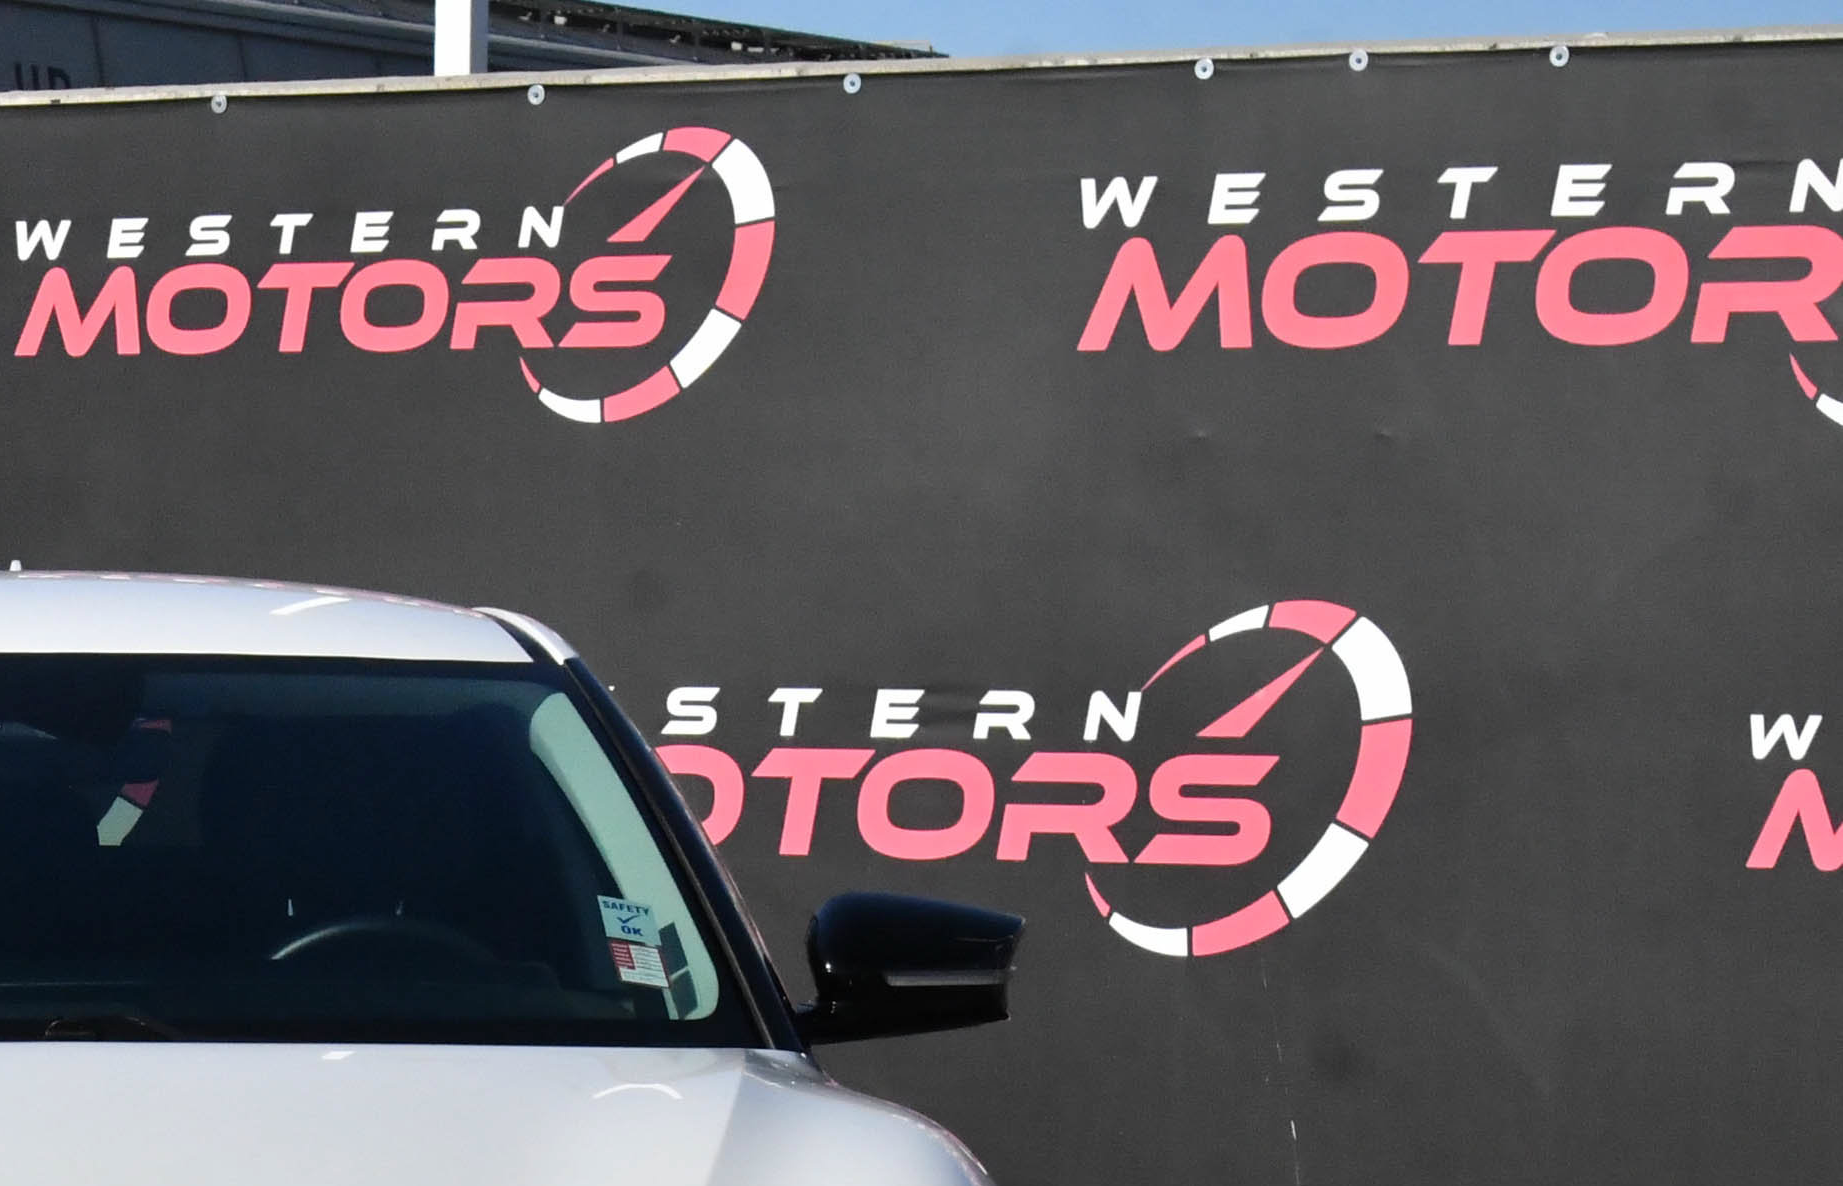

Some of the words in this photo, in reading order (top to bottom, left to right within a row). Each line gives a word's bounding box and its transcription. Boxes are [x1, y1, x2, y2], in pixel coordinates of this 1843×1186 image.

[1080, 157, 1843, 230] WESTERN
[15, 205, 565, 262] WESTERN
[15, 254, 672, 358] MOTORS
[1078, 224, 1843, 353] MOTOR
[603, 901, 649, 915] SAFETY
[620, 925, 644, 937] OK
